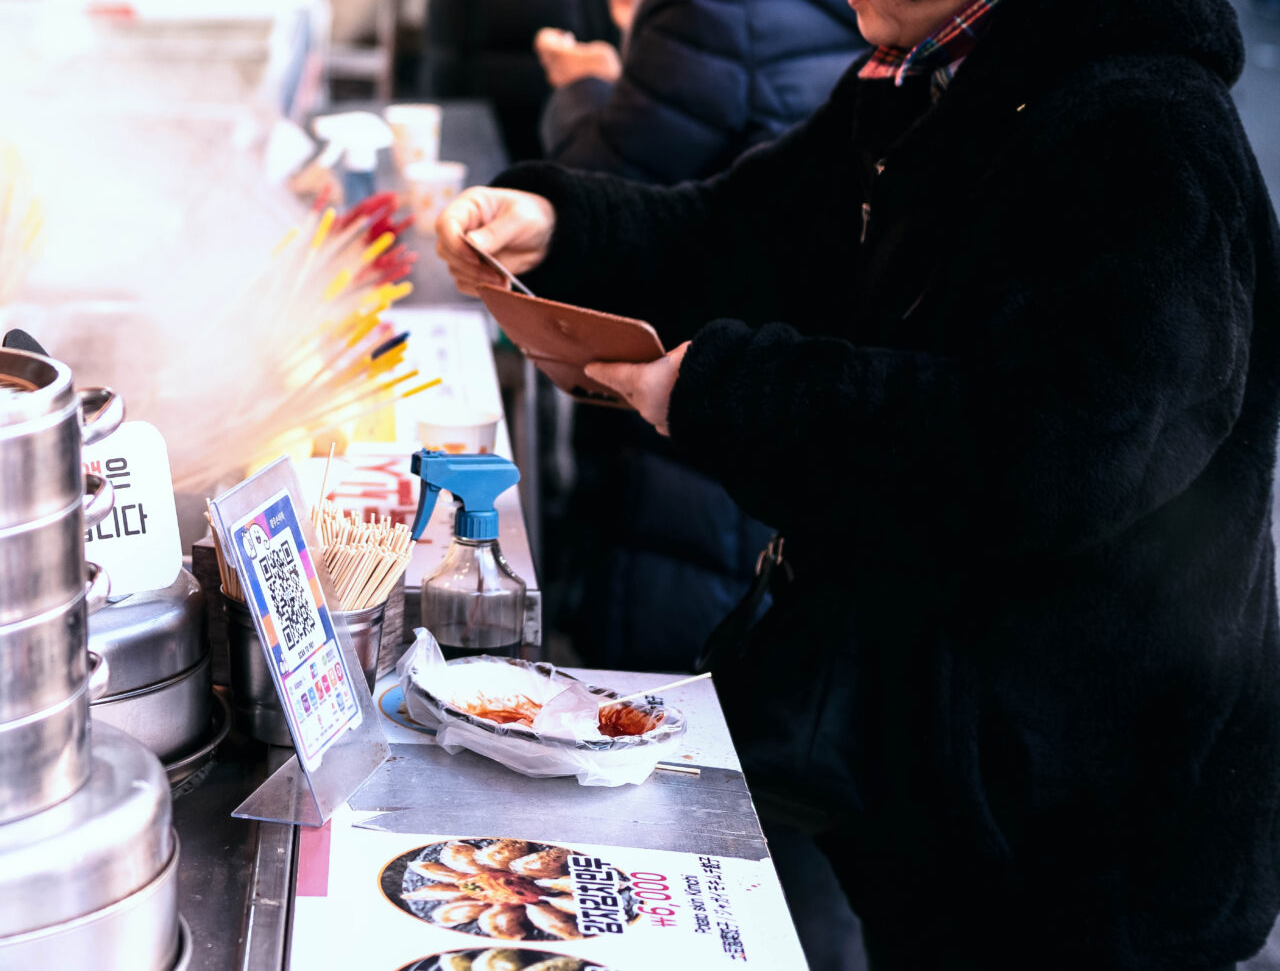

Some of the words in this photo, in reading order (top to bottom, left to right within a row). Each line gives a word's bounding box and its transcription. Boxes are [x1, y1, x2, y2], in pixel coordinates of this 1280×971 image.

[572, 857, 624, 934] 감자김치만두
[680, 874, 702, 897] Kimchi
[690, 897, 707, 912] skin
[694, 913, 712, 934] Potato
